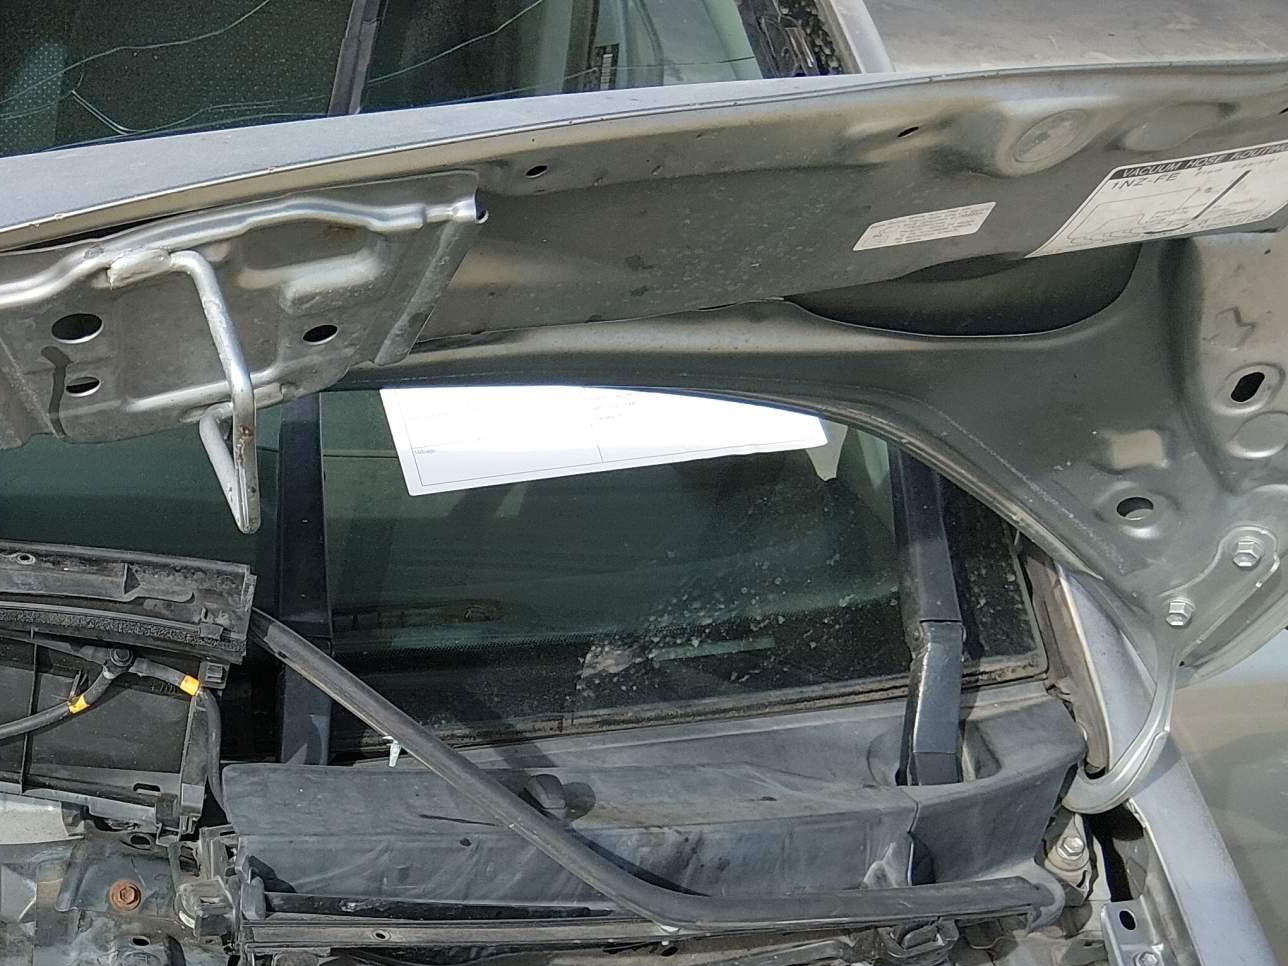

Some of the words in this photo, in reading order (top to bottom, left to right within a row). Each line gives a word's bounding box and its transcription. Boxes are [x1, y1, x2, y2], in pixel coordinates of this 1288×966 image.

[1123, 161, 1181, 177] VACUUM
[1187, 156, 1227, 170] HOSE
[1113, 172, 1181, 190] 1NZ-FE
